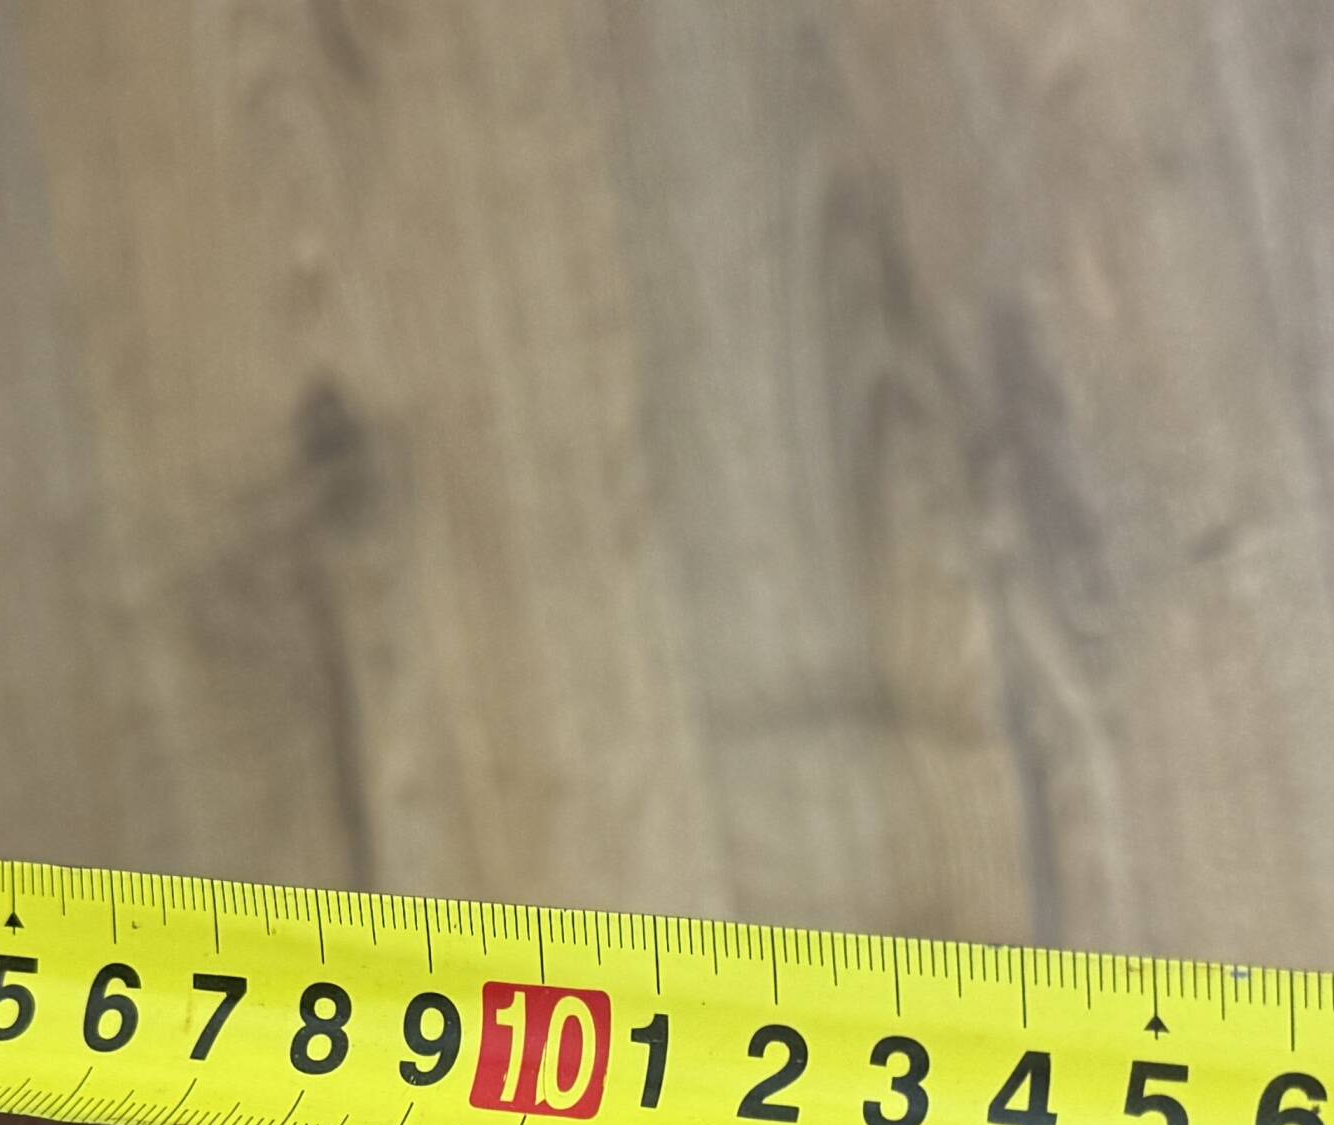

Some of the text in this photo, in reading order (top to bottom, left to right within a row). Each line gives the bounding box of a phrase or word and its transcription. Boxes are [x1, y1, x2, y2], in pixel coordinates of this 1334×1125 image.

[84, 963, 141, 1052] 6
[190, 974, 247, 1060] 7
[290, 983, 351, 1074] 8
[400, 992, 461, 1086] 9
[496, 991, 595, 1109] 10
[631, 1014, 668, 1108] 1
[737, 1025, 808, 1122] 2
